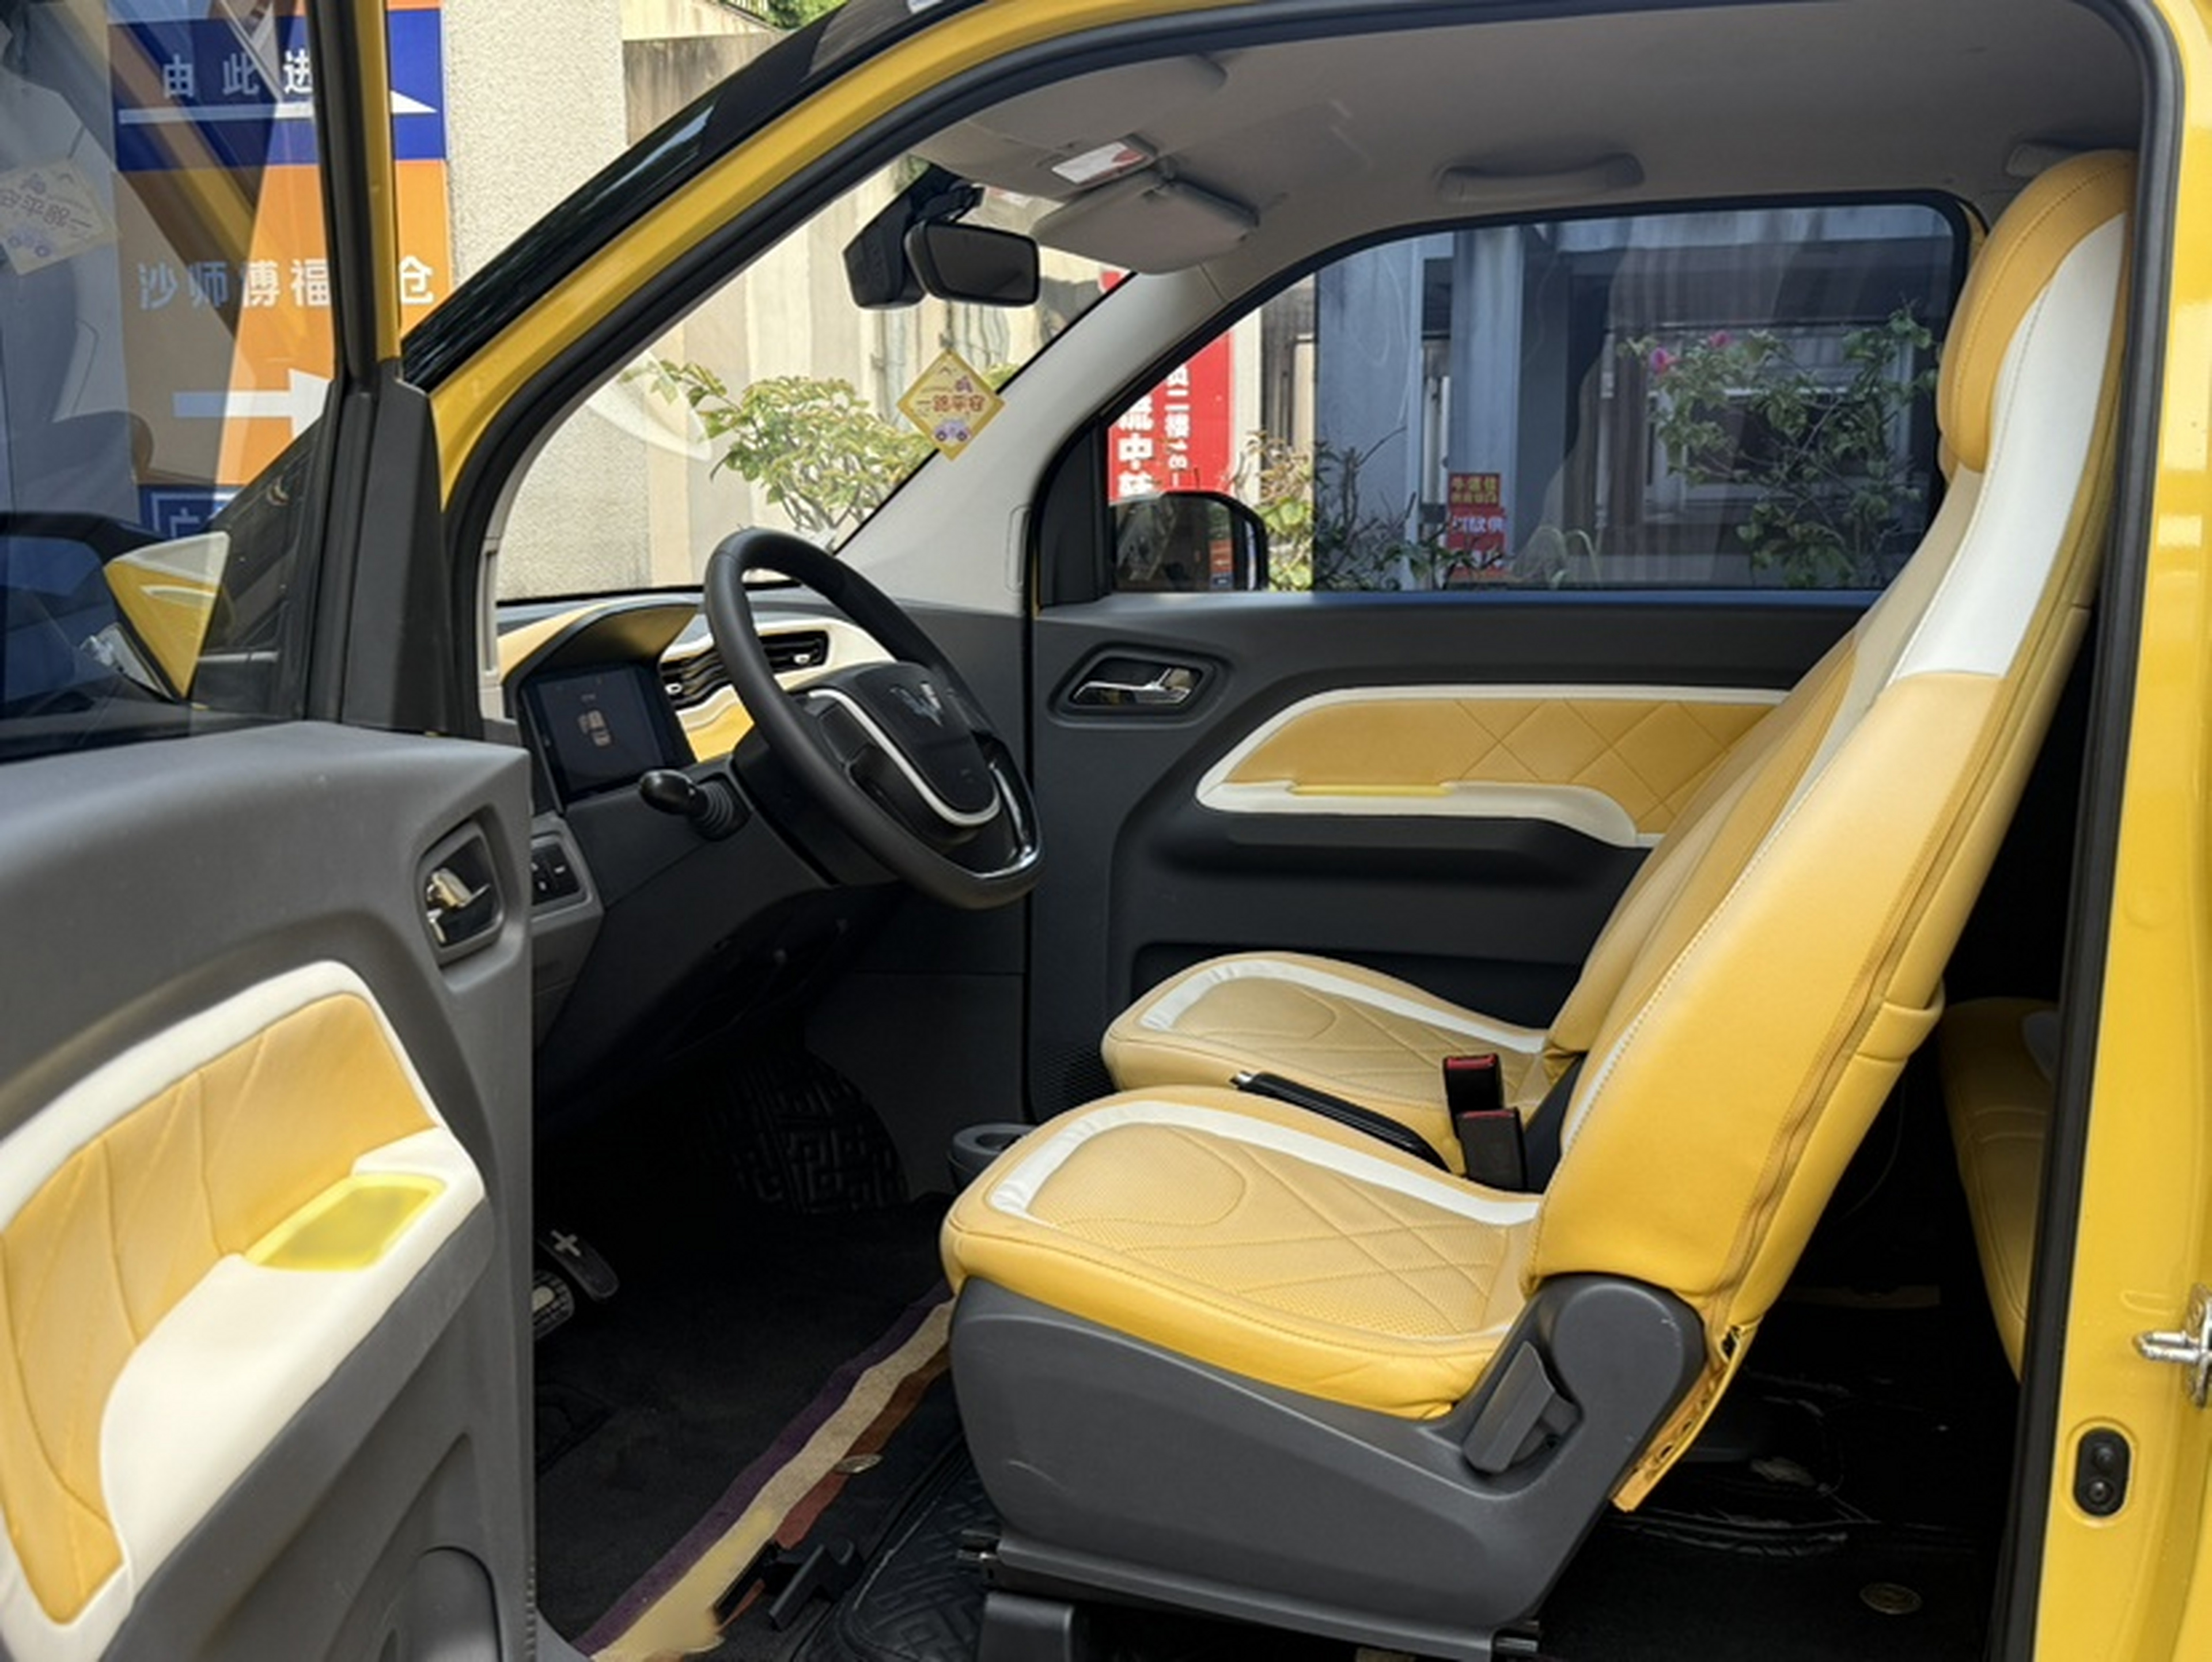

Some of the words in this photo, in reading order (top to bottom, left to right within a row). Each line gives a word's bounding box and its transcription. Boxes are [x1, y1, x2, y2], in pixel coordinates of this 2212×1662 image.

[138, 256, 435, 310] 沙师傅福仓
[916, 395, 986, 412] 一路平安
